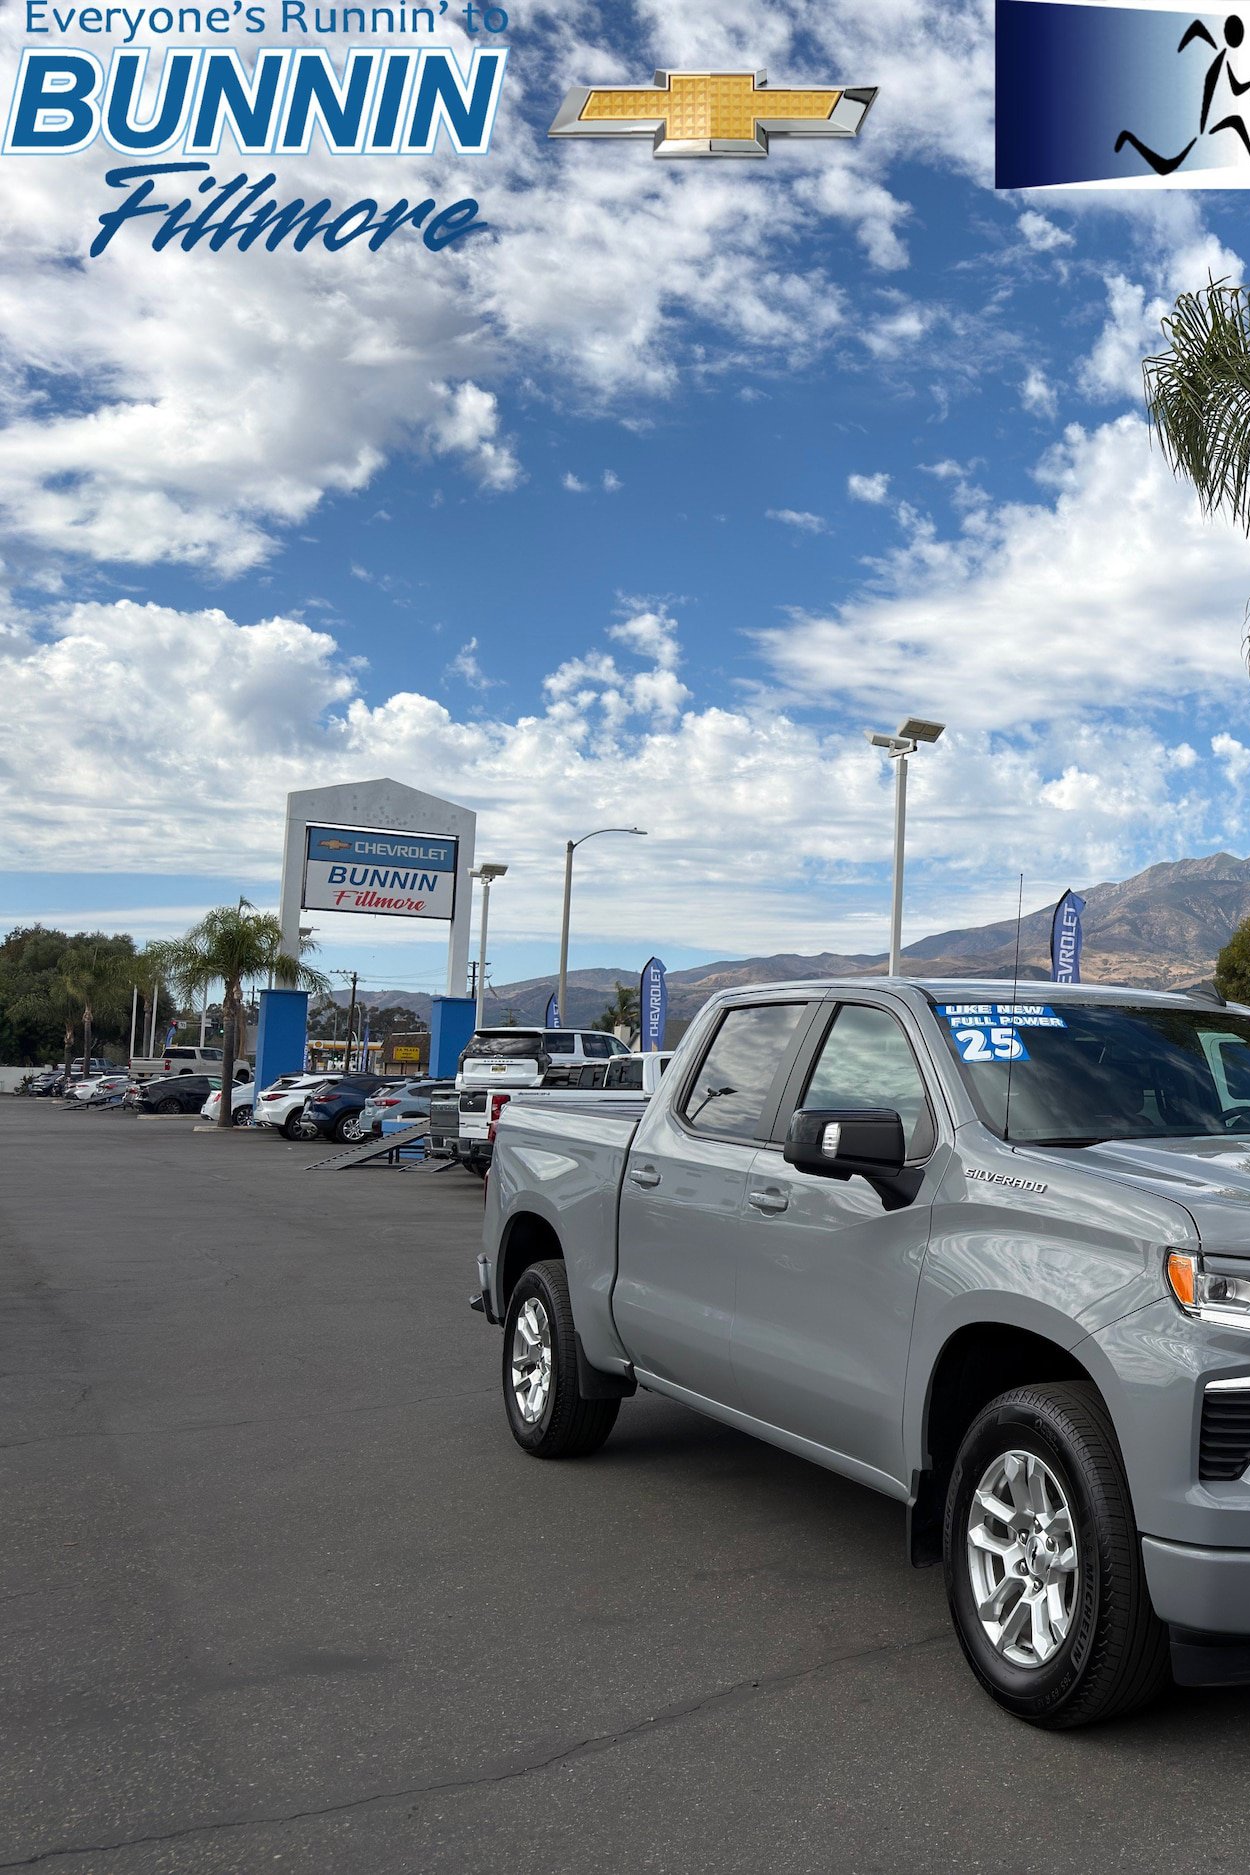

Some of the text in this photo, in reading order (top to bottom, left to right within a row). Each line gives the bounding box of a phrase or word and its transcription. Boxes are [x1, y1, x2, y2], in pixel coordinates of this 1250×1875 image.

[354, 840, 448, 861] CHEVROLET
[327, 865, 439, 892] BUNNIN
[333, 890, 428, 912] Fillmore
[649, 966, 662, 1037] CHEVROLET
[945, 1004, 1044, 1015] LIKE NEW
[951, 1016, 1065, 1027] FULL POWER
[955, 1027, 1024, 1062] 25
[964, 1168, 1048, 1194] SILVERADO
[1074, 1562, 1094, 1664] MICHELIN
